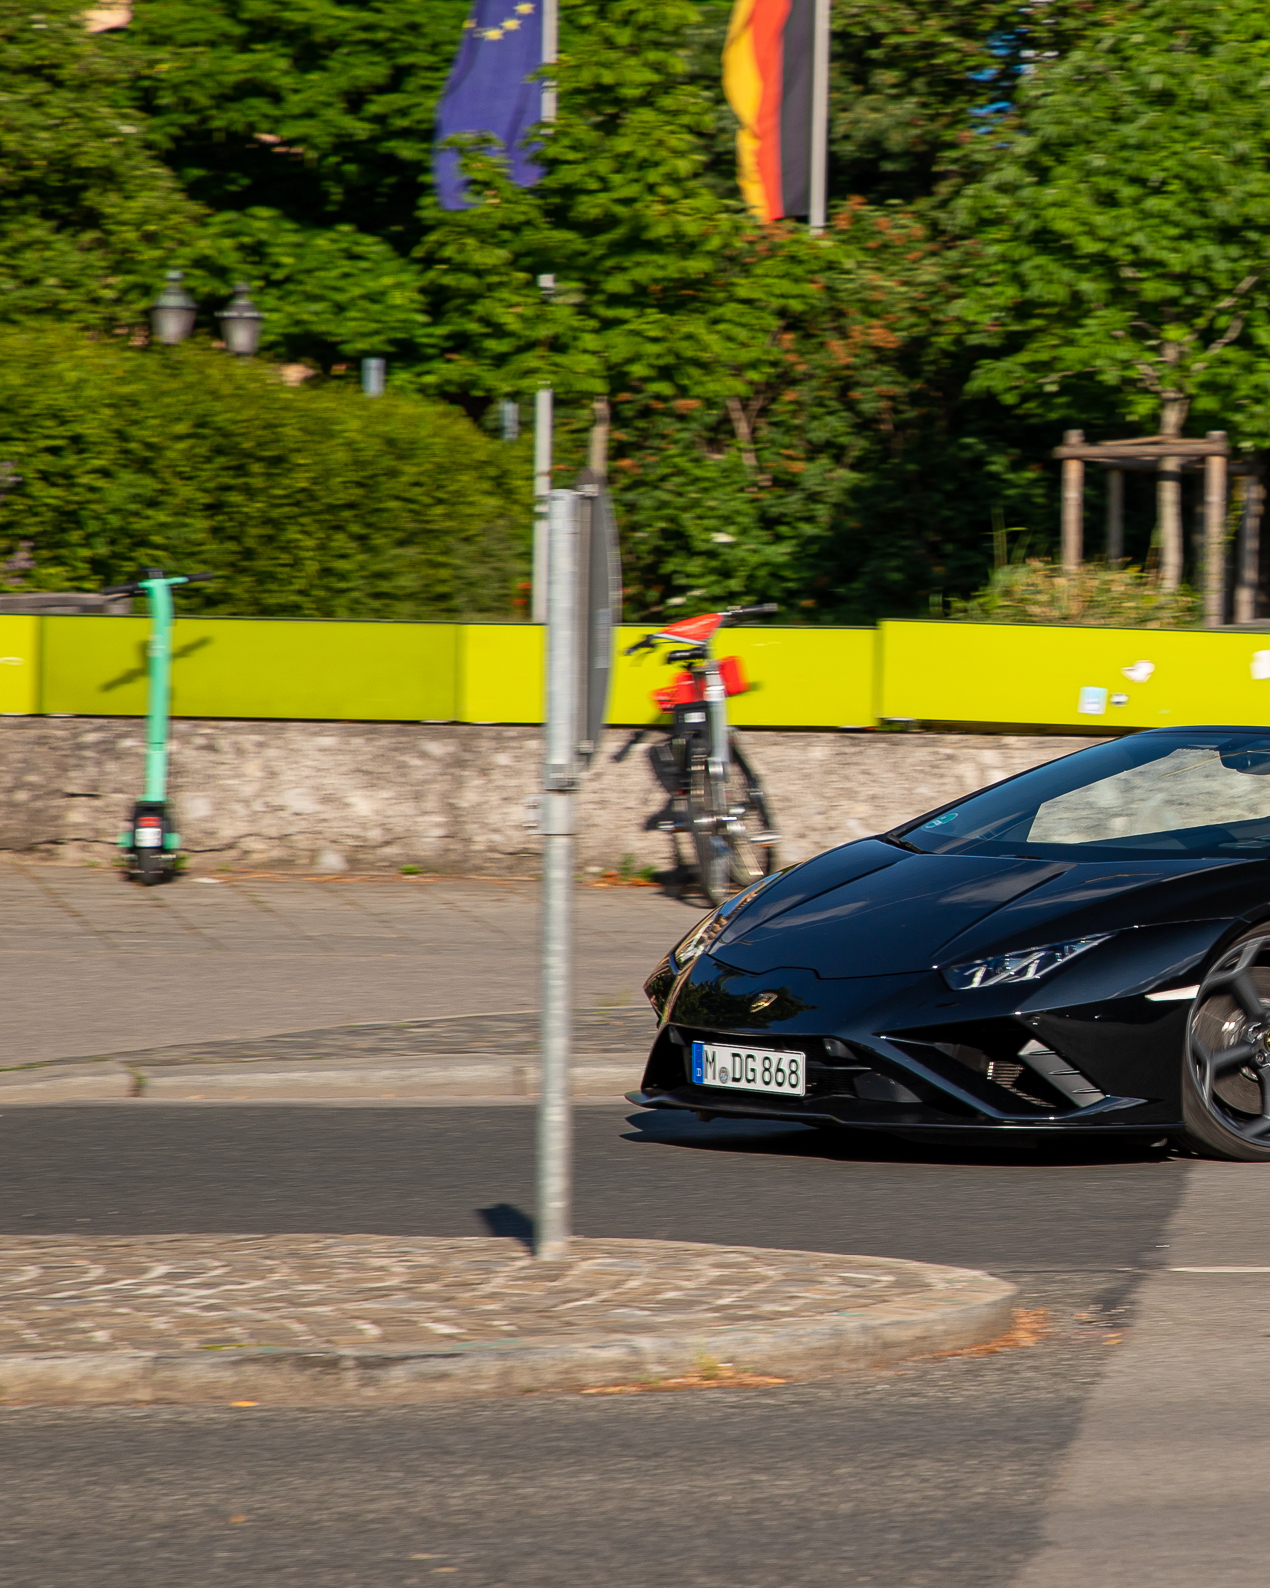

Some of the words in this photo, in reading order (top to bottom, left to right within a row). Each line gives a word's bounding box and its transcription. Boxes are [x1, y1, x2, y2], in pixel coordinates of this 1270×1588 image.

[704, 1049, 717, 1081] M
[731, 1052, 758, 1084] DG
[762, 1055, 801, 1088] 868
